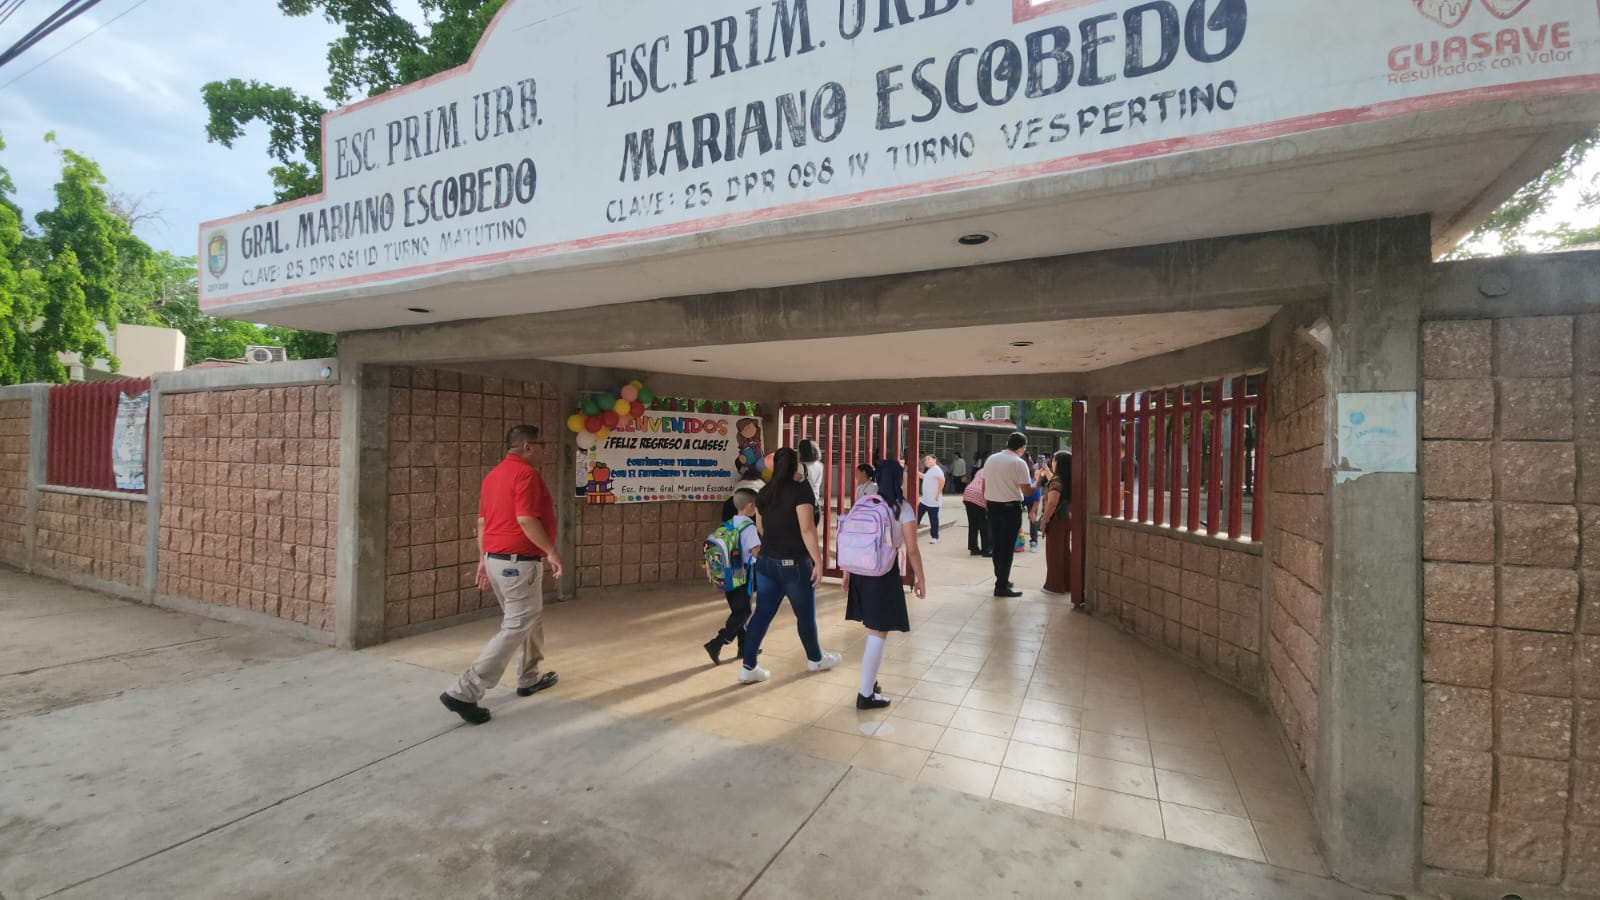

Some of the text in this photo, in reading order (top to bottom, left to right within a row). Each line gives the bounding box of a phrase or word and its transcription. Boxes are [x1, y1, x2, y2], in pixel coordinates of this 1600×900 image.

[606, 34, 677, 108] ESC.
[683, 0, 826, 86] PRIM.
[1388, 22, 1570, 72] GUASAVE
[1388, 48, 1573, 85] Resultados con Valor
[335, 78, 543, 180] ESC. PRIM. URB.
[619, 0, 1249, 183] MARIANO ESCOBEDO
[606, 191, 674, 223] CLAVE:
[685, 181, 712, 209] 25
[726, 168, 776, 201] DPR
[788, 157, 834, 189] 098
[886, 131, 975, 172] TURNO
[999, 80, 1239, 151] VESPERTINO
[241, 157, 537, 260] GRAL. MARIANO ESCOBEDO
[242, 264, 281, 287] CLAVE:
[286, 260, 304, 280] 25
[384, 236, 430, 261] TURNO
[440, 216, 527, 252] MATUTINO
[616, 416, 729, 436] ENVENIDOS
[640, 437, 682, 450] REGRESO
[683, 438, 690, 450] A
[692, 439, 729, 452] CLASES!
